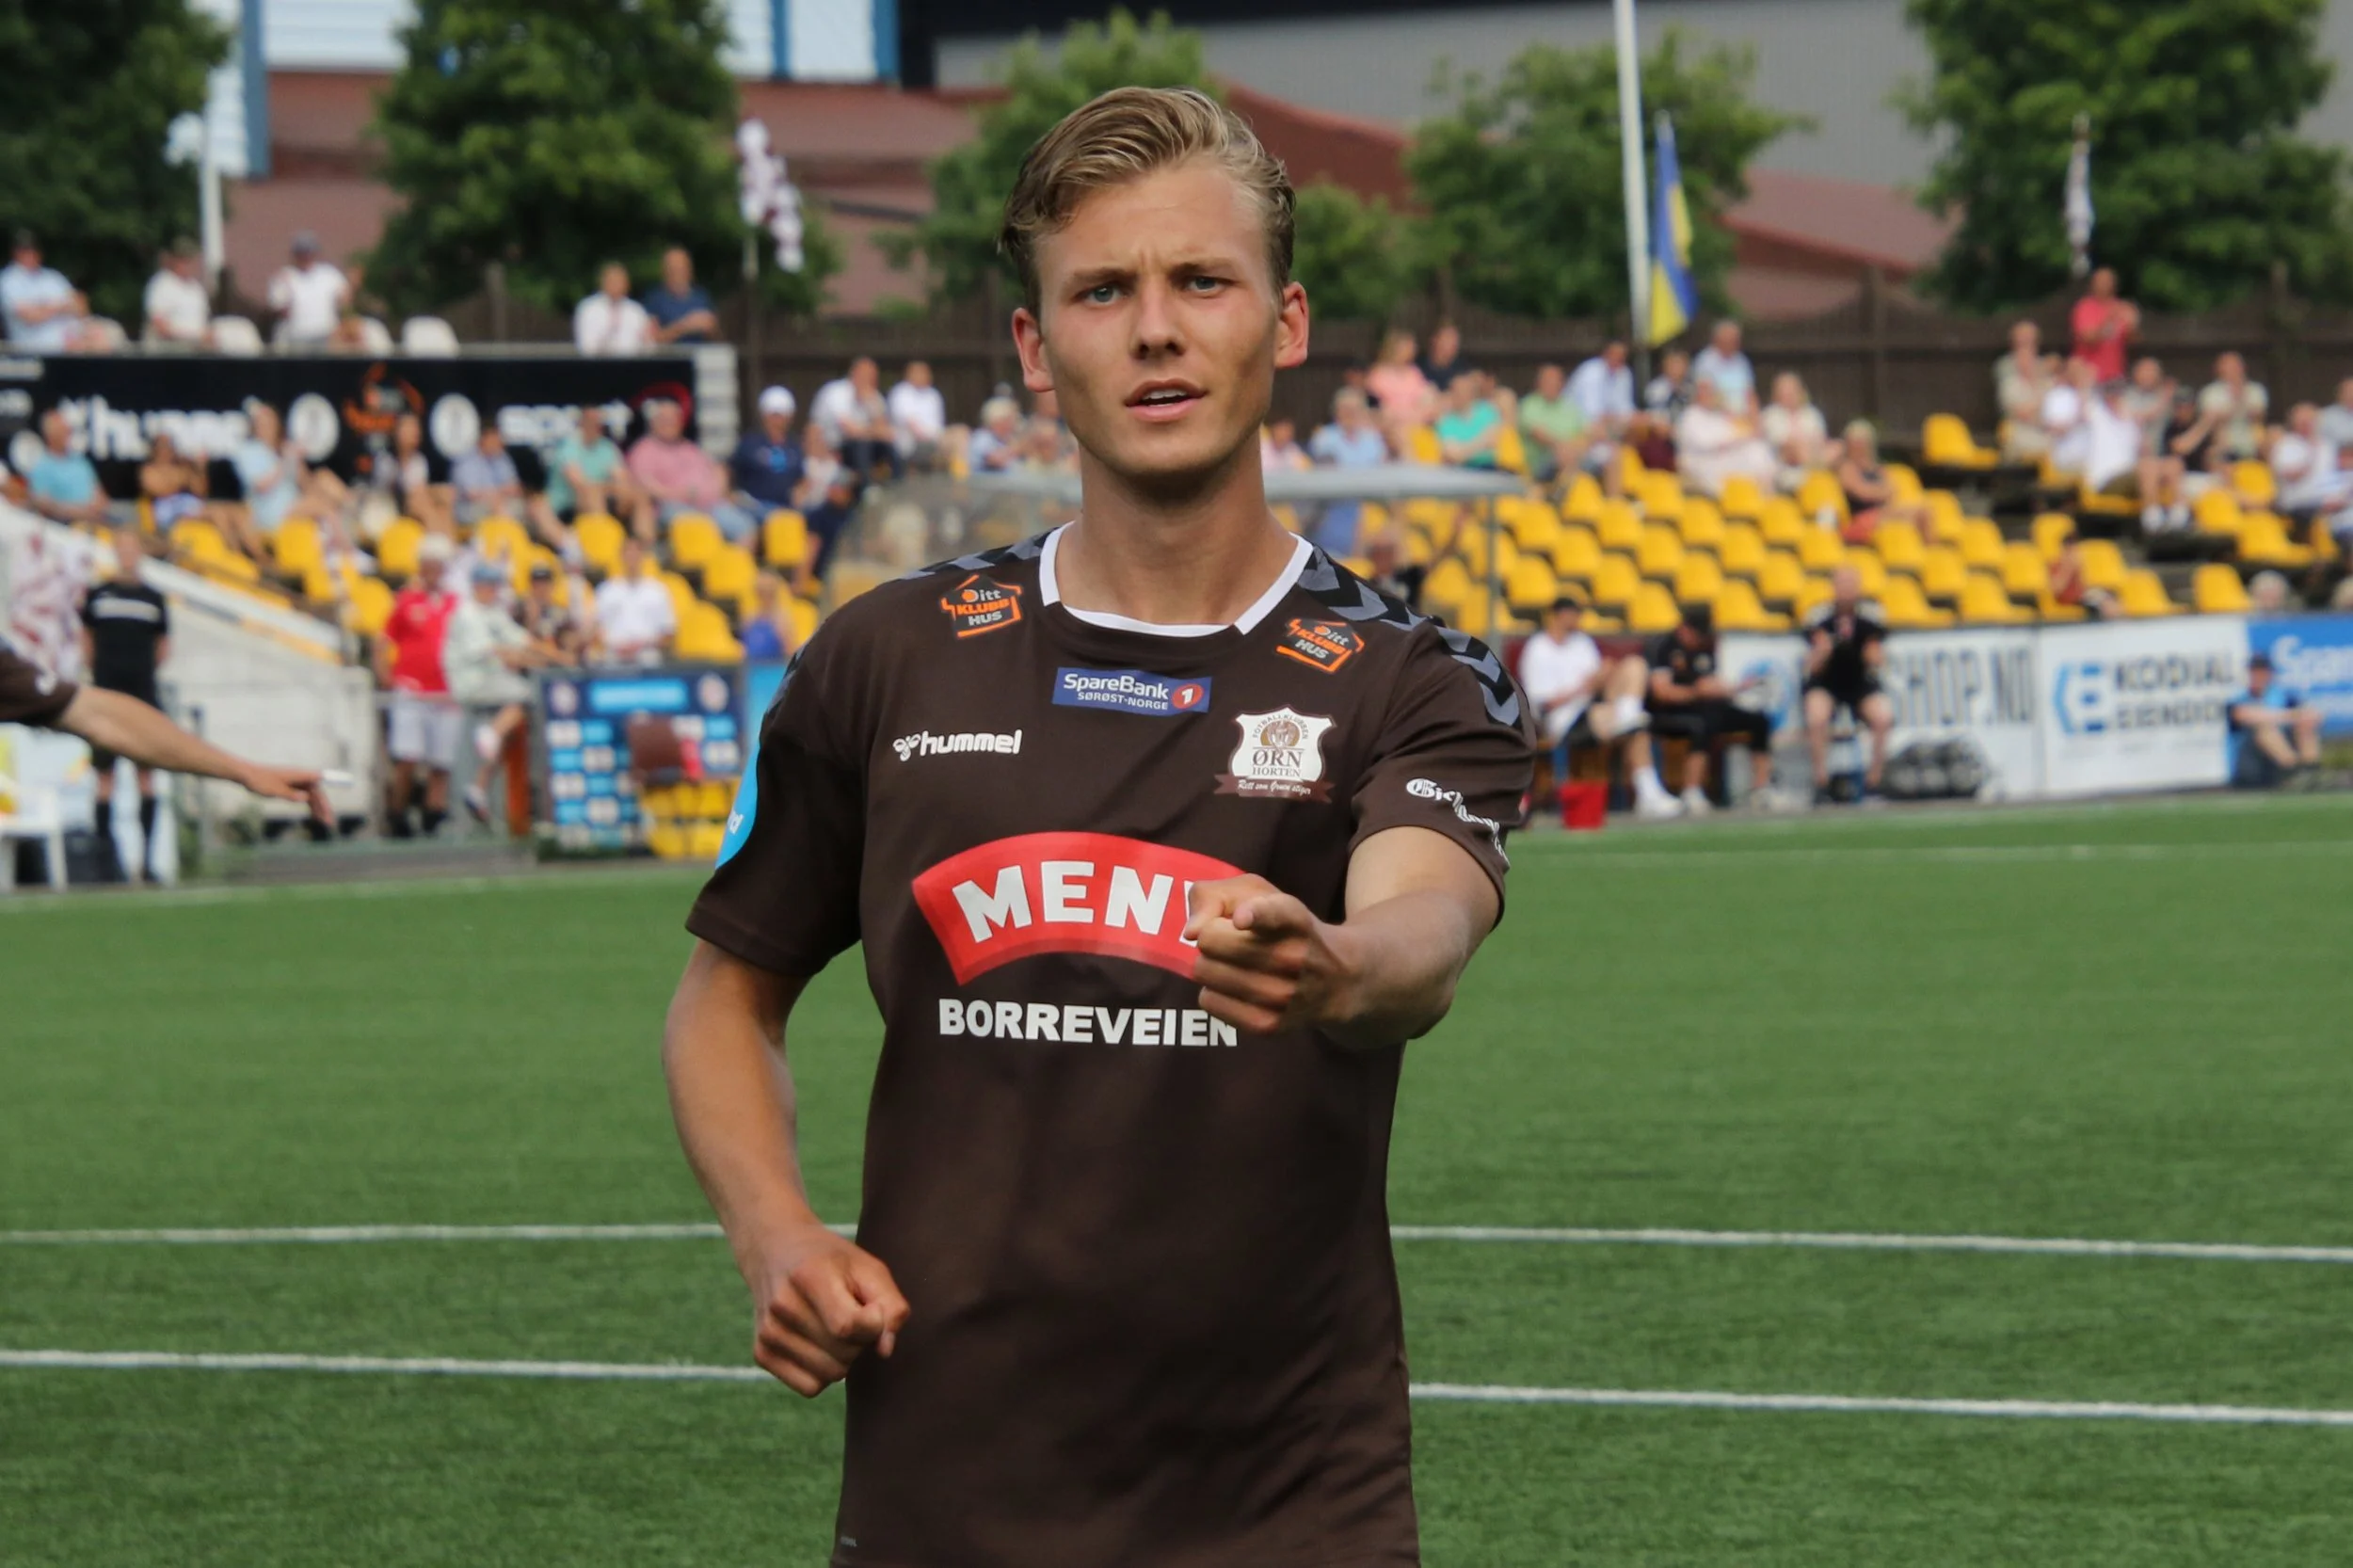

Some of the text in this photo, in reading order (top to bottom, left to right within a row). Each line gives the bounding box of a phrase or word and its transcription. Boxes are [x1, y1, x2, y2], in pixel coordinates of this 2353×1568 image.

[90, 393, 260, 461] humme
[962, 589, 1001, 603] Ditt
[968, 611, 1002, 626] HUS
[1314, 625, 1350, 647] Ditt
[1295, 639, 1330, 659] HUS
[1064, 673, 1194, 705] SpareBank 1
[920, 729, 1023, 757] hummel
[1253, 749, 1303, 768] ØRN
[1252, 767, 1302, 777] HORTEN
[952, 861, 1198, 948] MEN
[939, 999, 1238, 1047] BORREVEIEN
